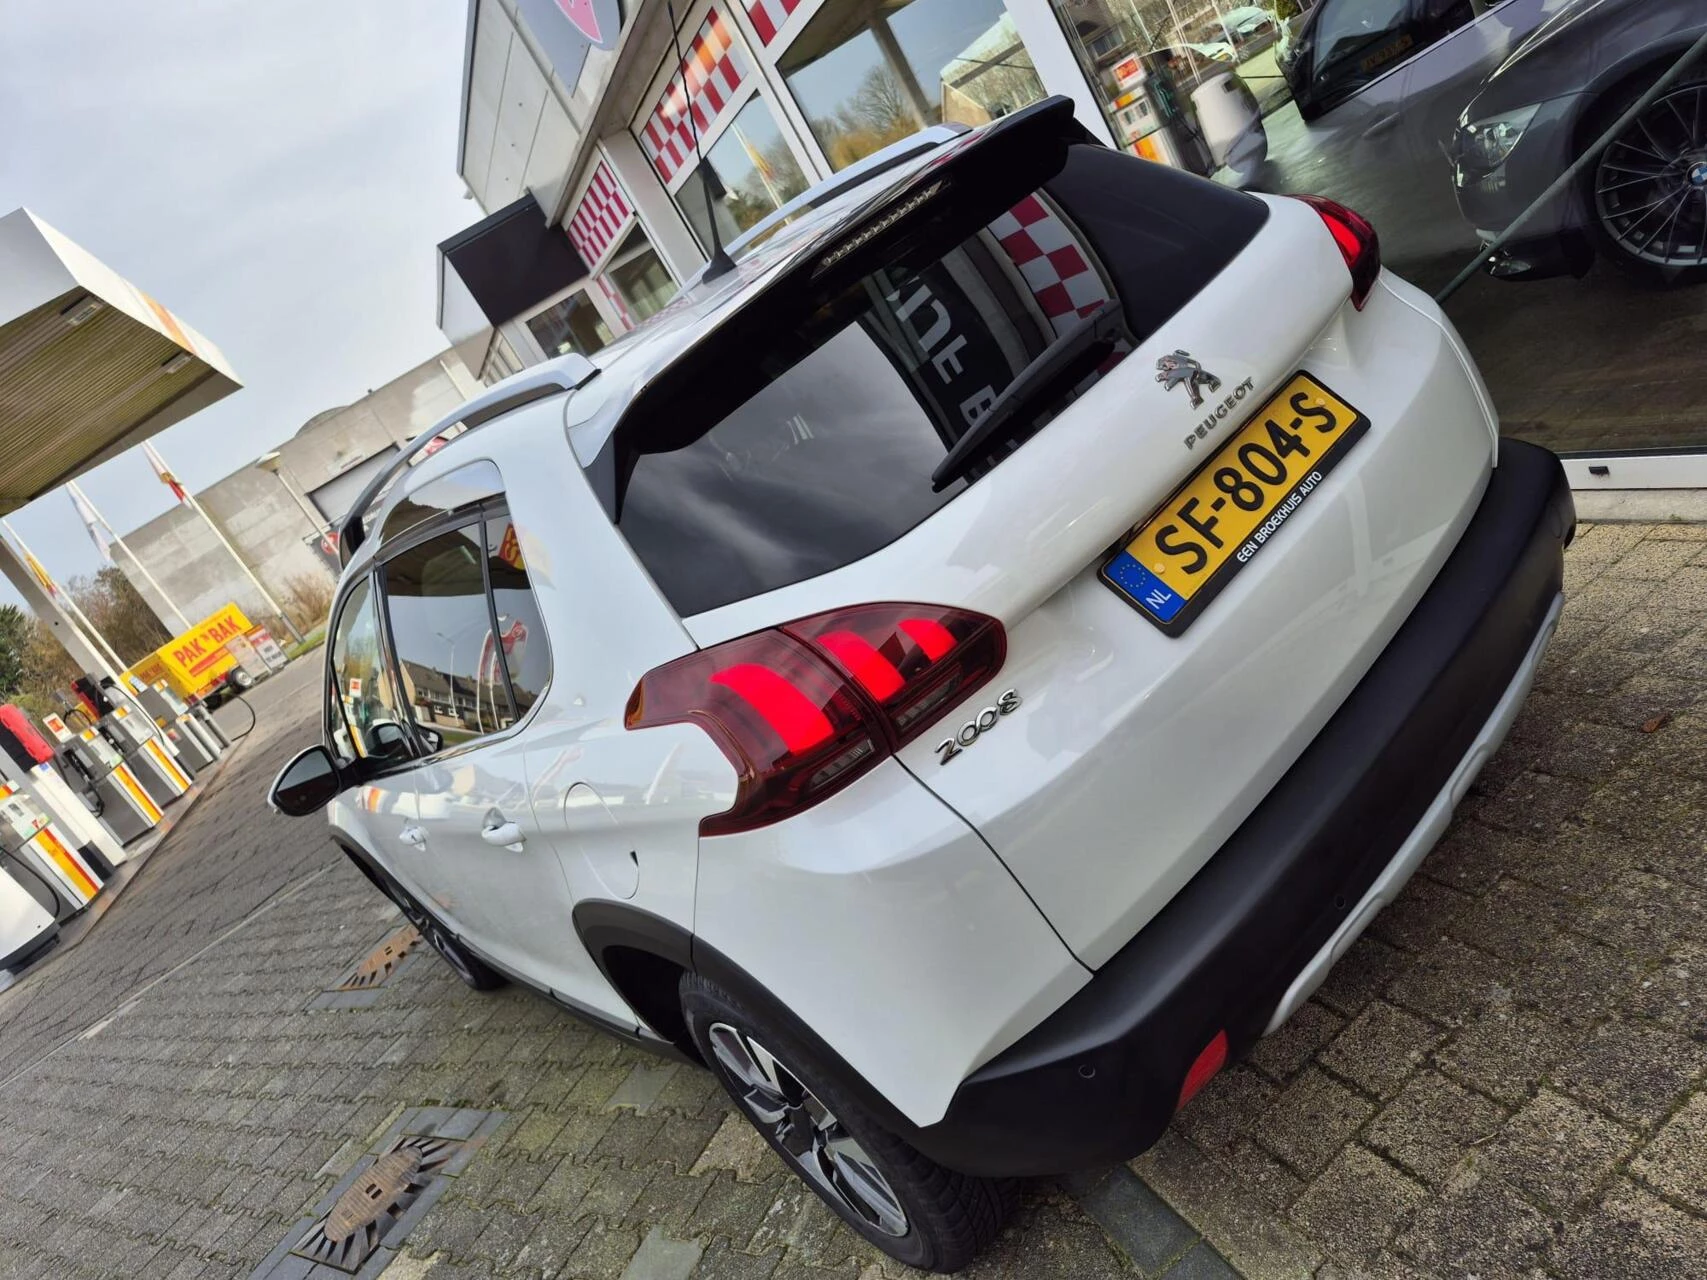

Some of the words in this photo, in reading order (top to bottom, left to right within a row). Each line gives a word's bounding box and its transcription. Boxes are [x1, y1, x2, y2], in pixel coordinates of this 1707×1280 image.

[1184, 376, 1255, 450] PEUGEOT
[1155, 391, 1337, 575] SF-804-S
[1236, 540, 1259, 563] EEN
[1254, 492, 1303, 544] BROEKHUIS
[1300, 471, 1323, 496] AUTO
[1146, 588, 1172, 609] NL
[173, 638, 207, 668] PAK
[207, 615, 242, 644] BAK
[935, 688, 1023, 766] 2008
